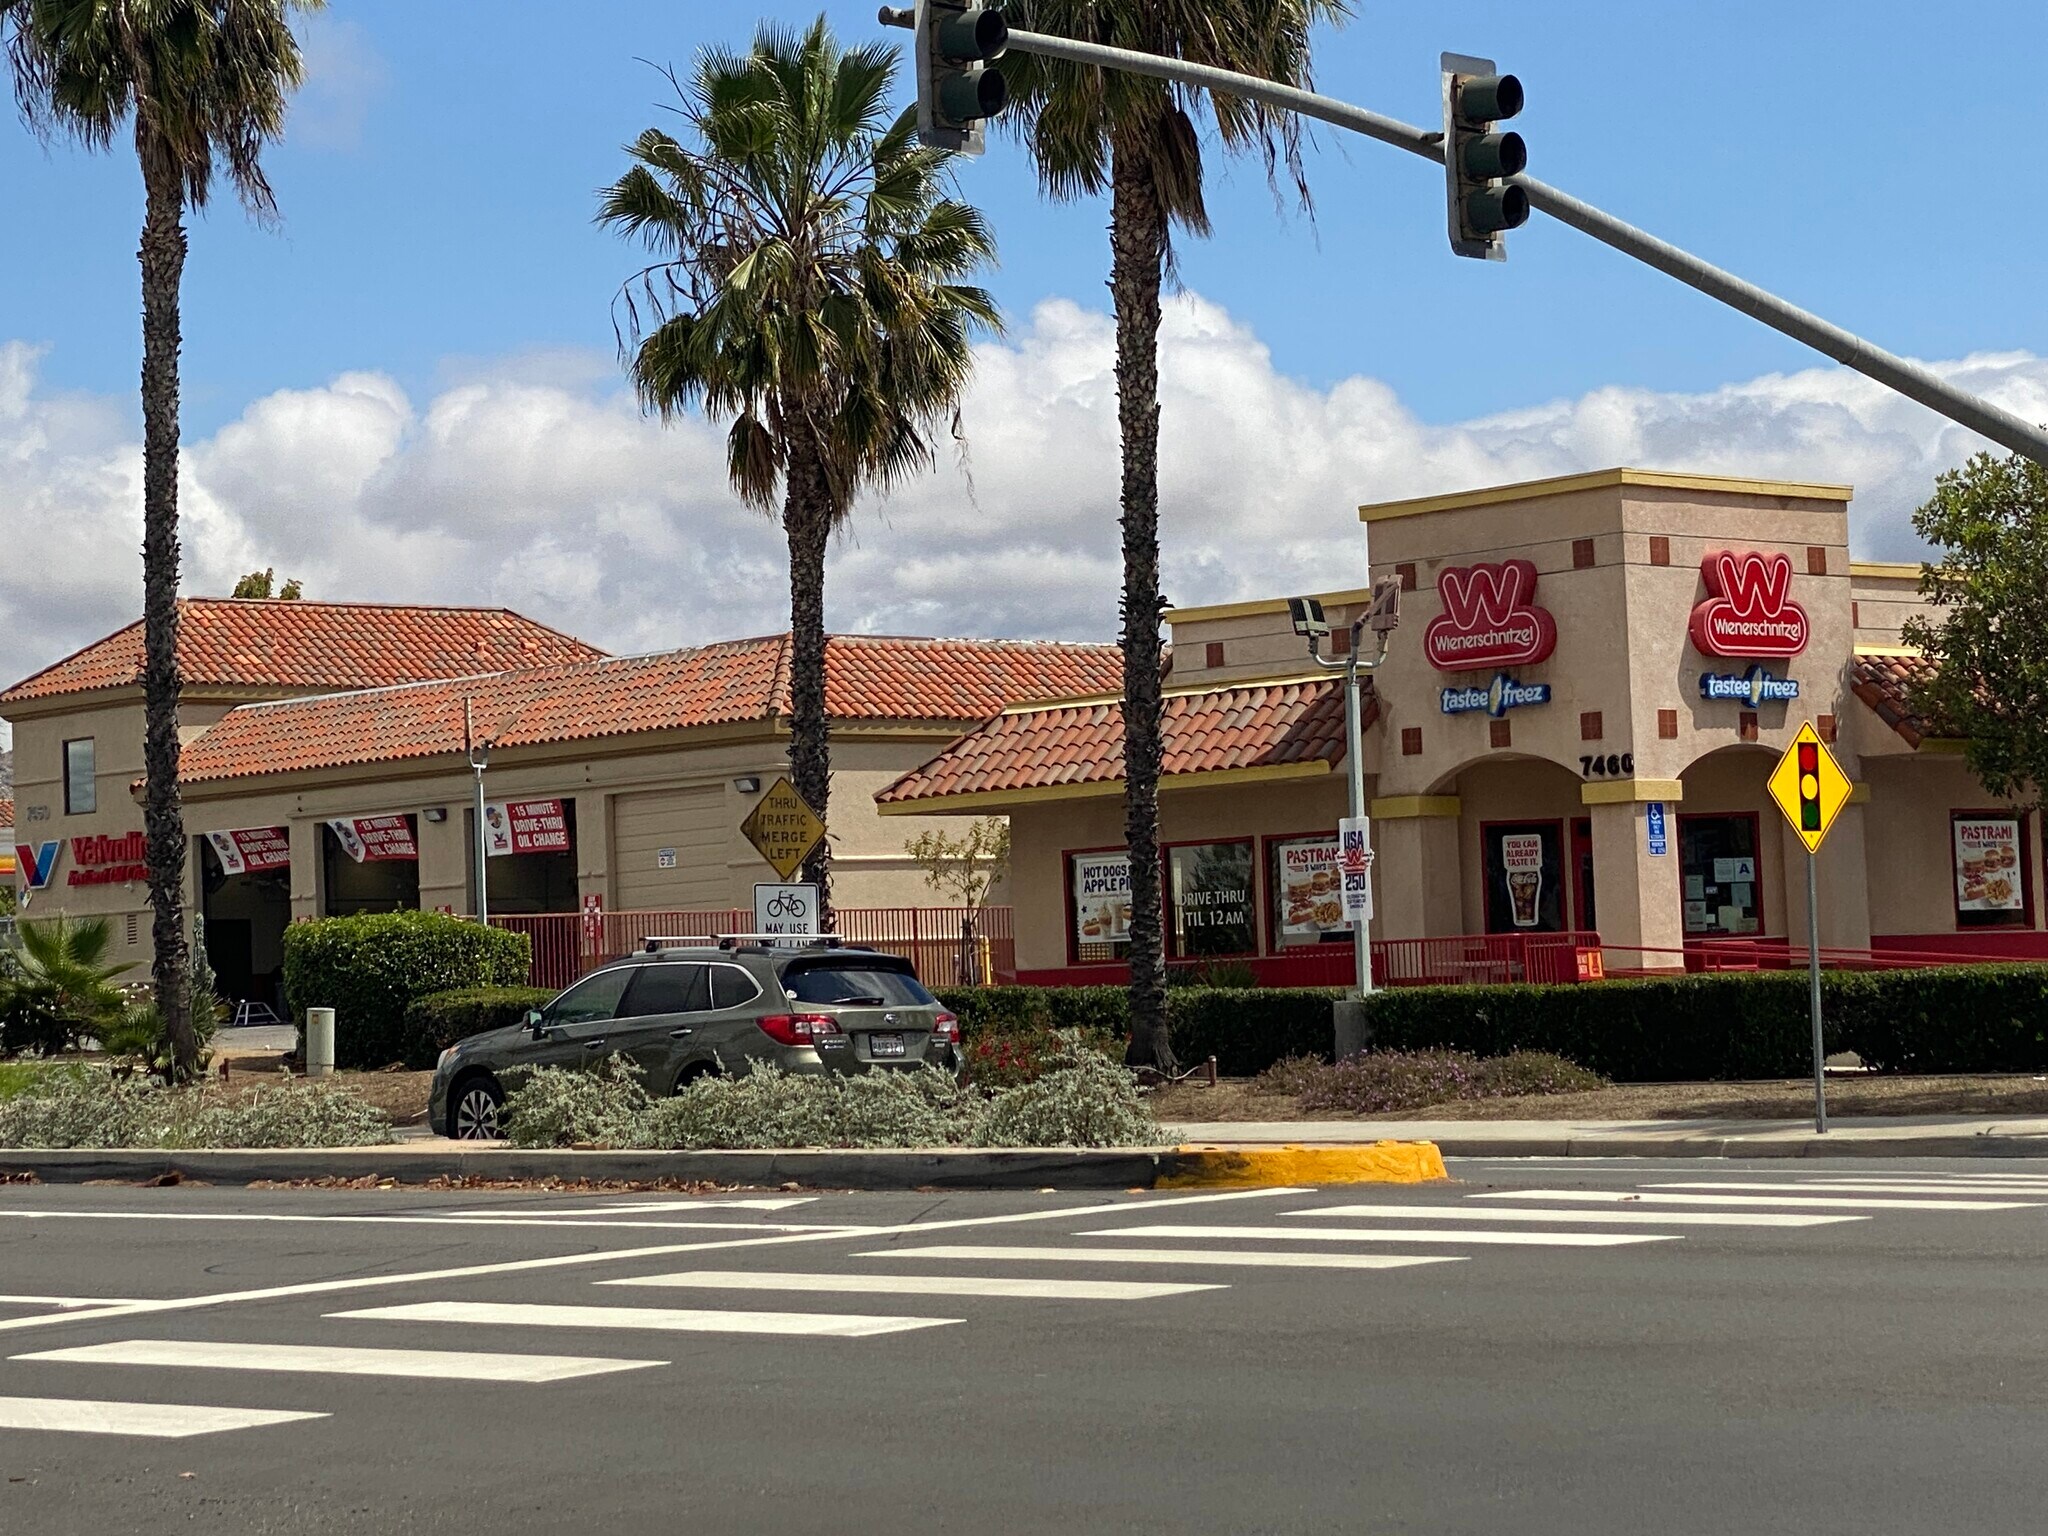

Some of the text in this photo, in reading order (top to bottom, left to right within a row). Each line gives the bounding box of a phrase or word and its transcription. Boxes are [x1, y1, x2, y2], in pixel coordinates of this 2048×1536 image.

[1720, 556, 1790, 618] W
[1441, 564, 1521, 631] W
[1714, 618, 1801, 641] Wienerschnitzel
[1435, 625, 1534, 652] Wienerschnitzel
[1708, 674, 1798, 697] tastee freez
[1442, 682, 1543, 712] tastee freez
[1579, 753, 1635, 776] 7460
[515, 802, 556, 816] 15 MINUTE
[768, 797, 798, 809] THRU
[361, 820, 372, 830] 15
[513, 816, 564, 833] DRIVE-THRU
[761, 814, 807, 826] TRAFFIC
[361, 829, 411, 844] DRIVE-THRU
[517, 834, 532, 848] OIL
[533, 831, 566, 847] CHANGE
[761, 831, 808, 843] MERGE
[1343, 830, 1364, 850] USA
[1961, 825, 2013, 840] PASTRAMI
[384, 842, 416, 855] CHANGE
[1507, 841, 1521, 849] YOU
[769, 848, 801, 860] LEFT
[1287, 847, 1340, 865] PASTRAM
[1506, 849, 1539, 858] ALREADY
[1507, 858, 1529, 866] TASTE
[1083, 864, 1127, 879] HOT DOGS
[1084, 876, 1131, 893] APPLE PI
[1345, 871, 1366, 891] 250
[1181, 890, 1245, 906] DRIVE THRU
[765, 922, 809, 934] MAY USE
